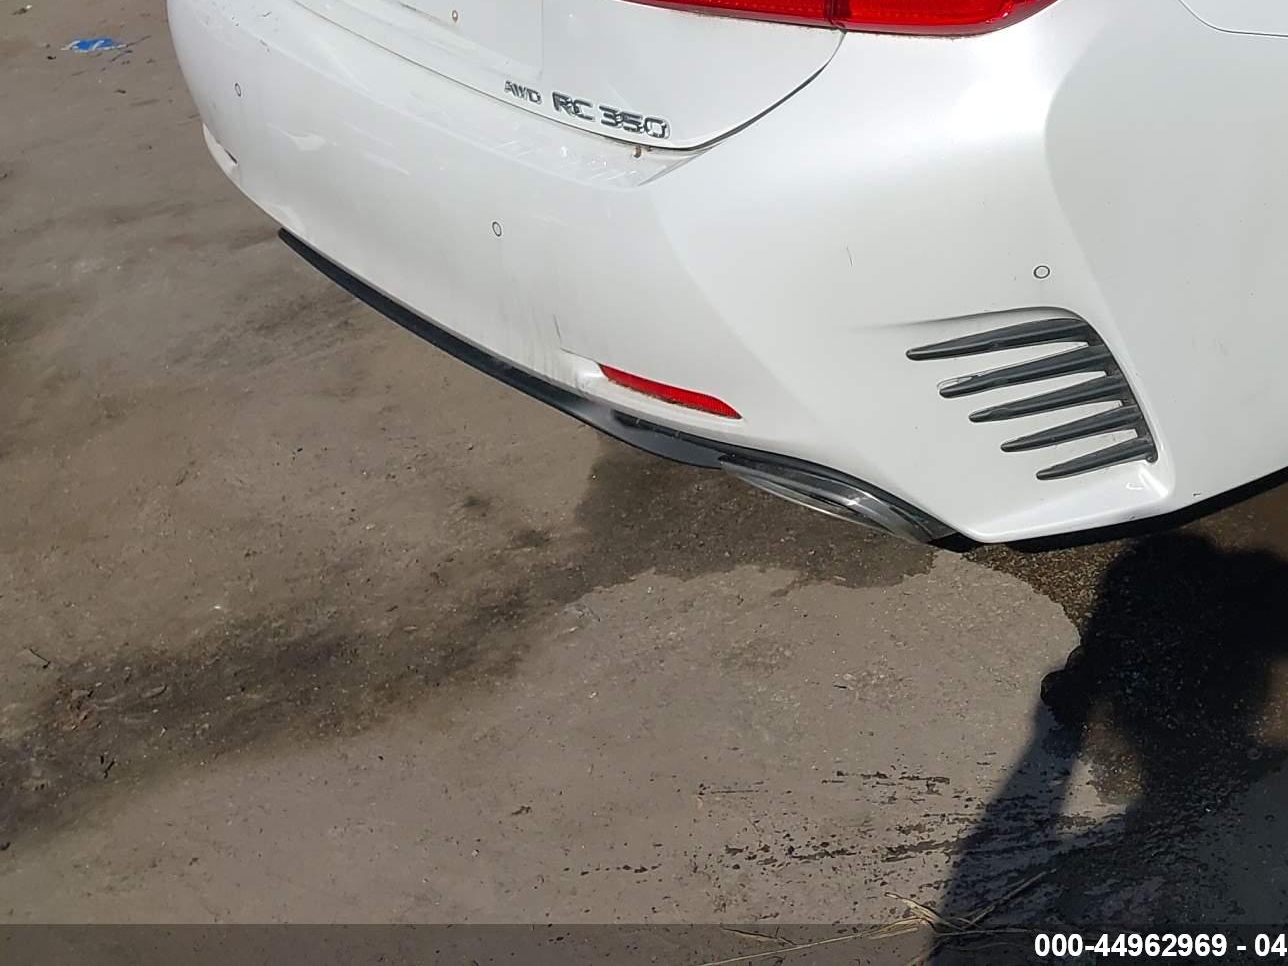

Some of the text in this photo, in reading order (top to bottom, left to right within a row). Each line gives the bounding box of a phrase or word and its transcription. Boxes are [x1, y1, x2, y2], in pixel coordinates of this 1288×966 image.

[504, 80, 542, 105] AWD
[552, 91, 671, 139] RC 350
